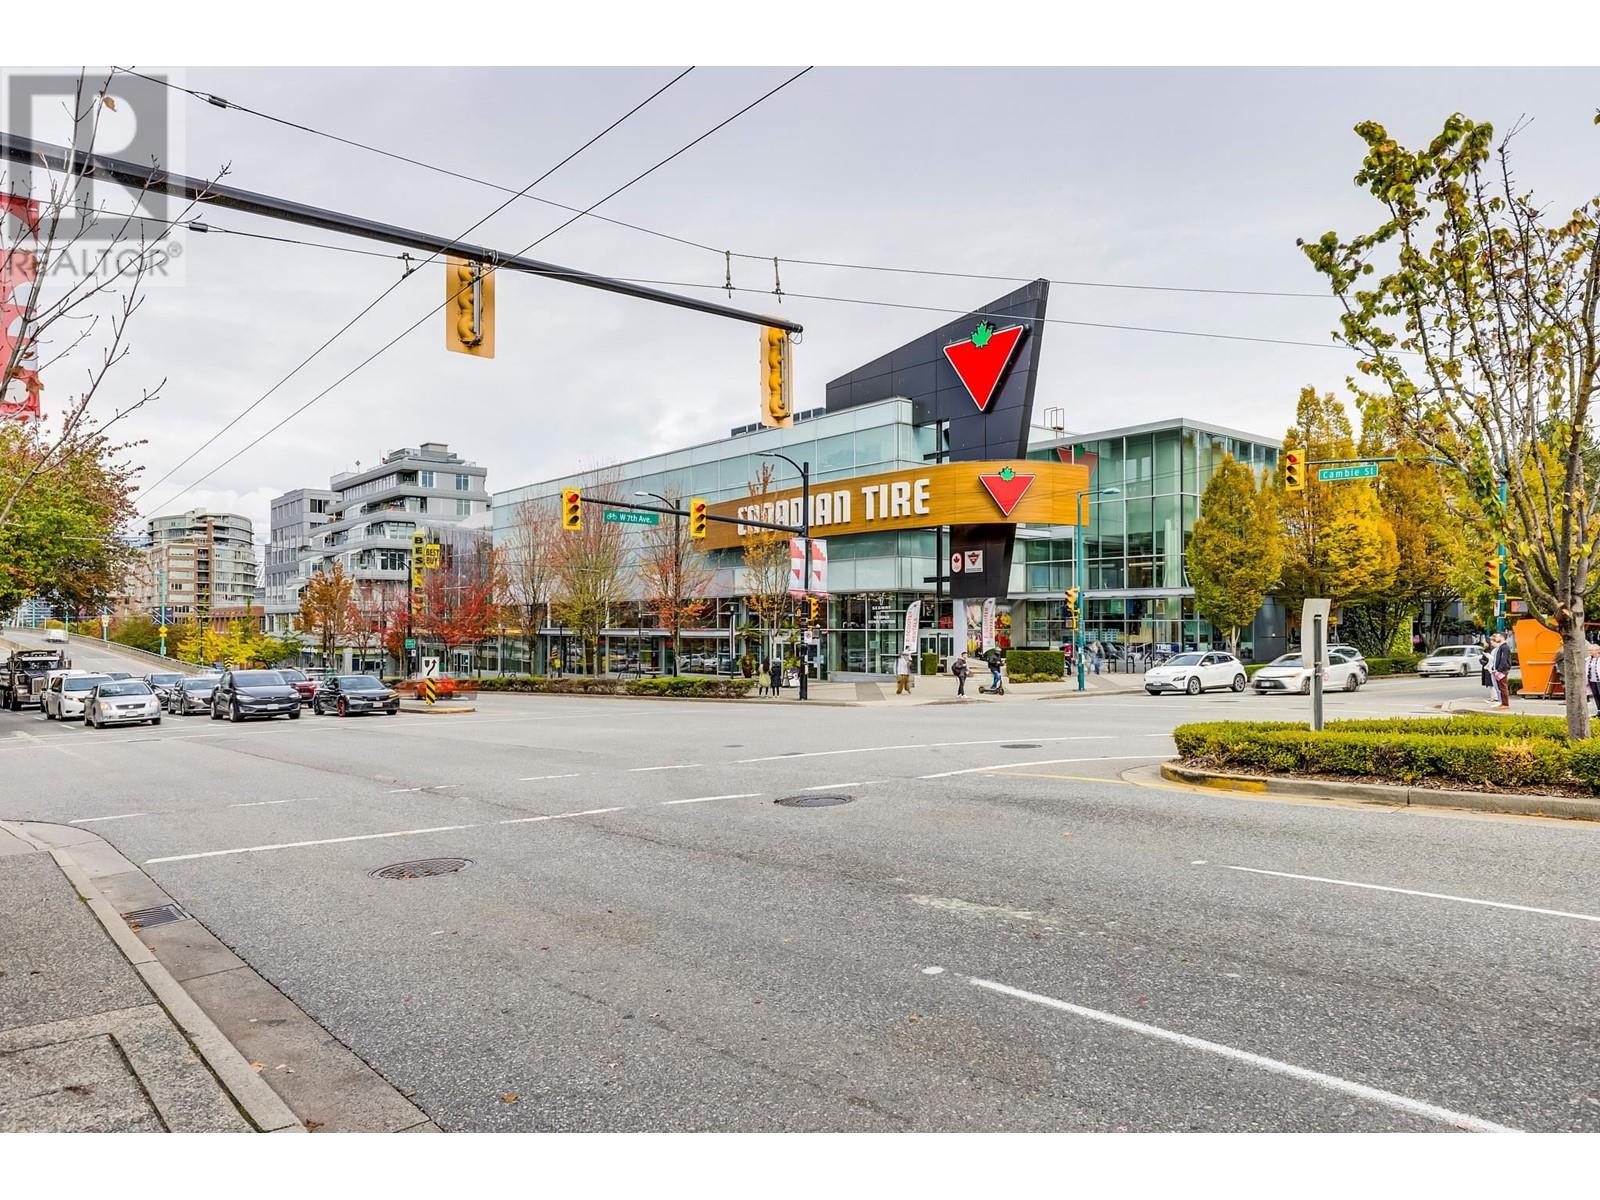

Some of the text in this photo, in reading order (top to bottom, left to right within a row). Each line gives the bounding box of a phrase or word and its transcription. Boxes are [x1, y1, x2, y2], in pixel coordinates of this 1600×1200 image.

[1323, 467, 1374, 479] Cambie St
[862, 478, 931, 520] TIRE
[626, 514, 638, 522] 7th
[426, 548, 440, 557] BEST
